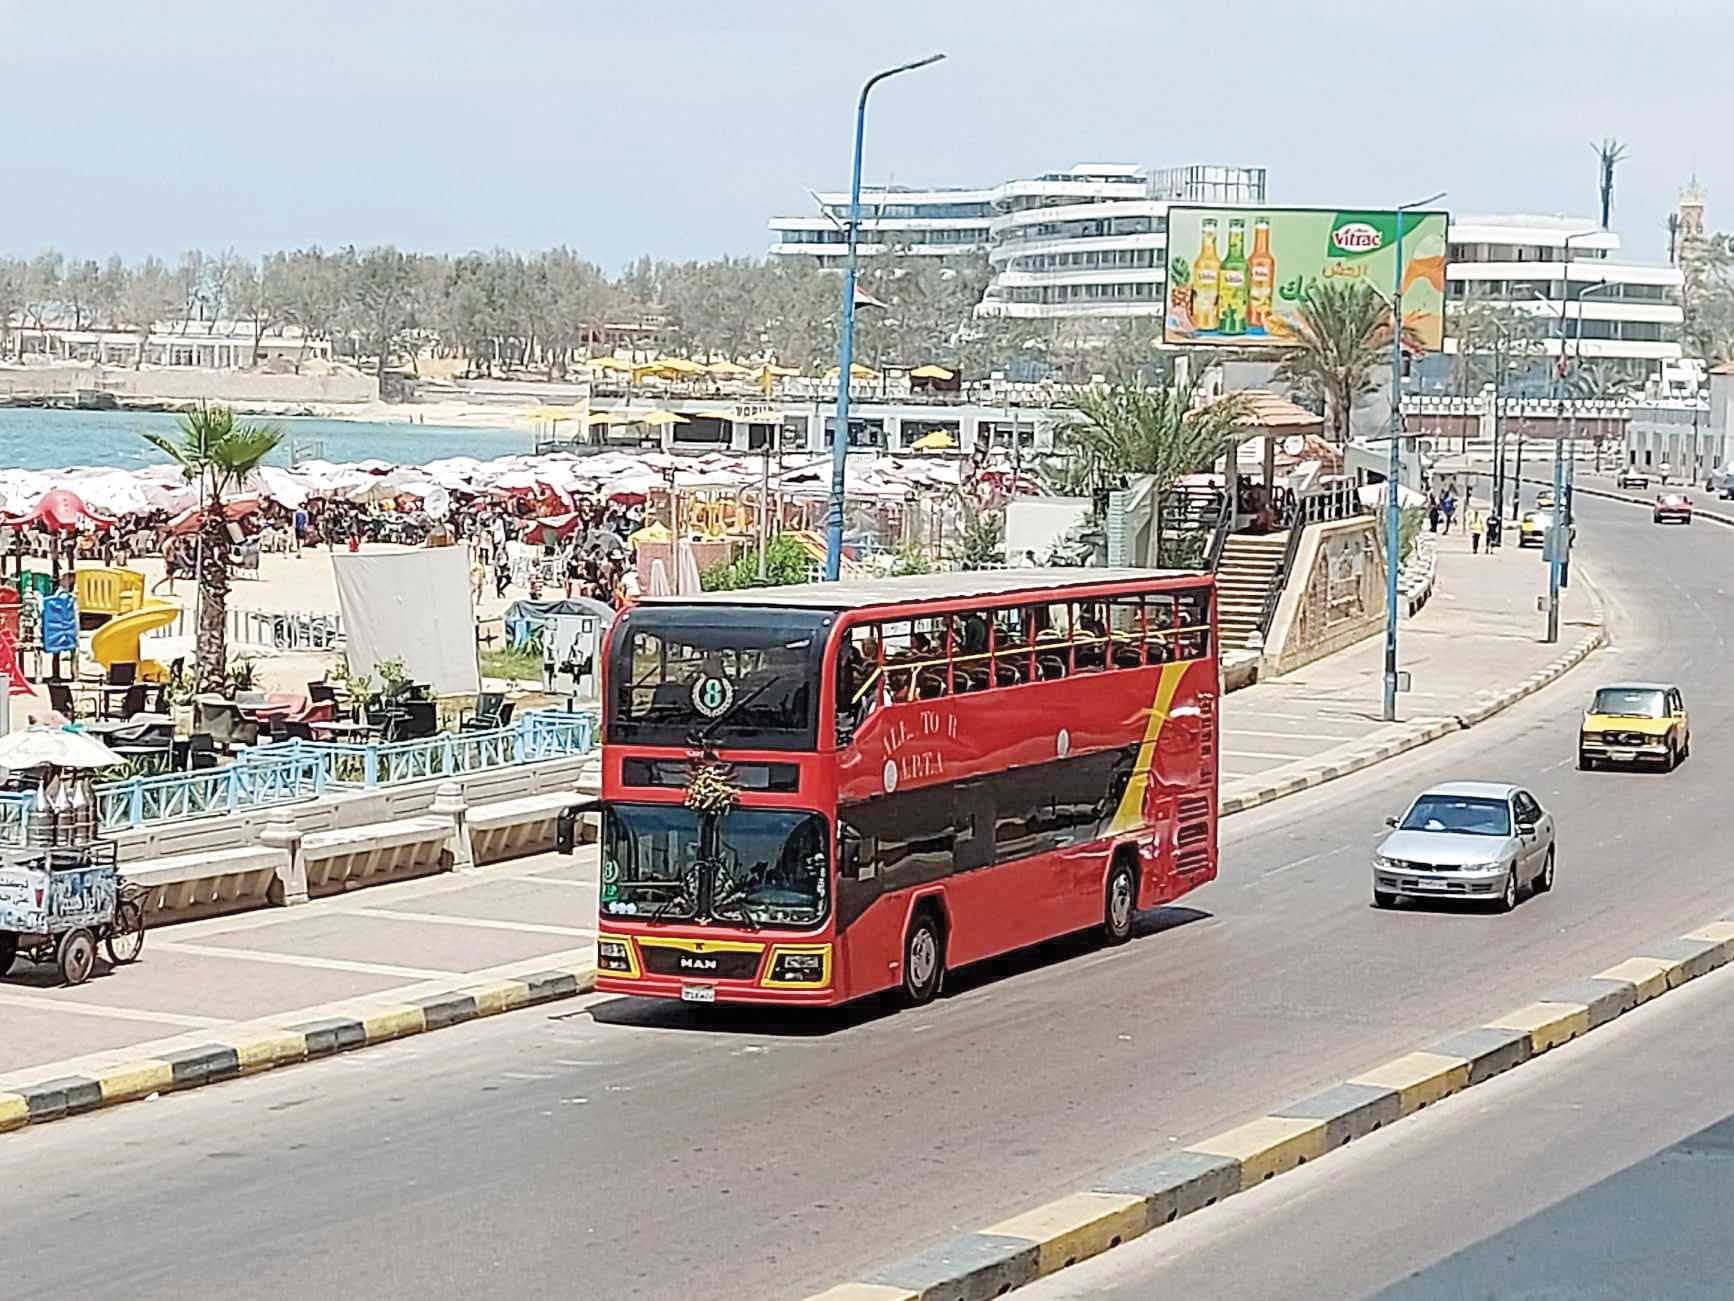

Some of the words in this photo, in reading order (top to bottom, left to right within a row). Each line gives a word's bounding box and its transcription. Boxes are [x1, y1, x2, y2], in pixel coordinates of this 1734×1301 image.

[704, 679, 721, 708] 8
[920, 710, 958, 740] TOR
[680, 958, 717, 969] MAN
